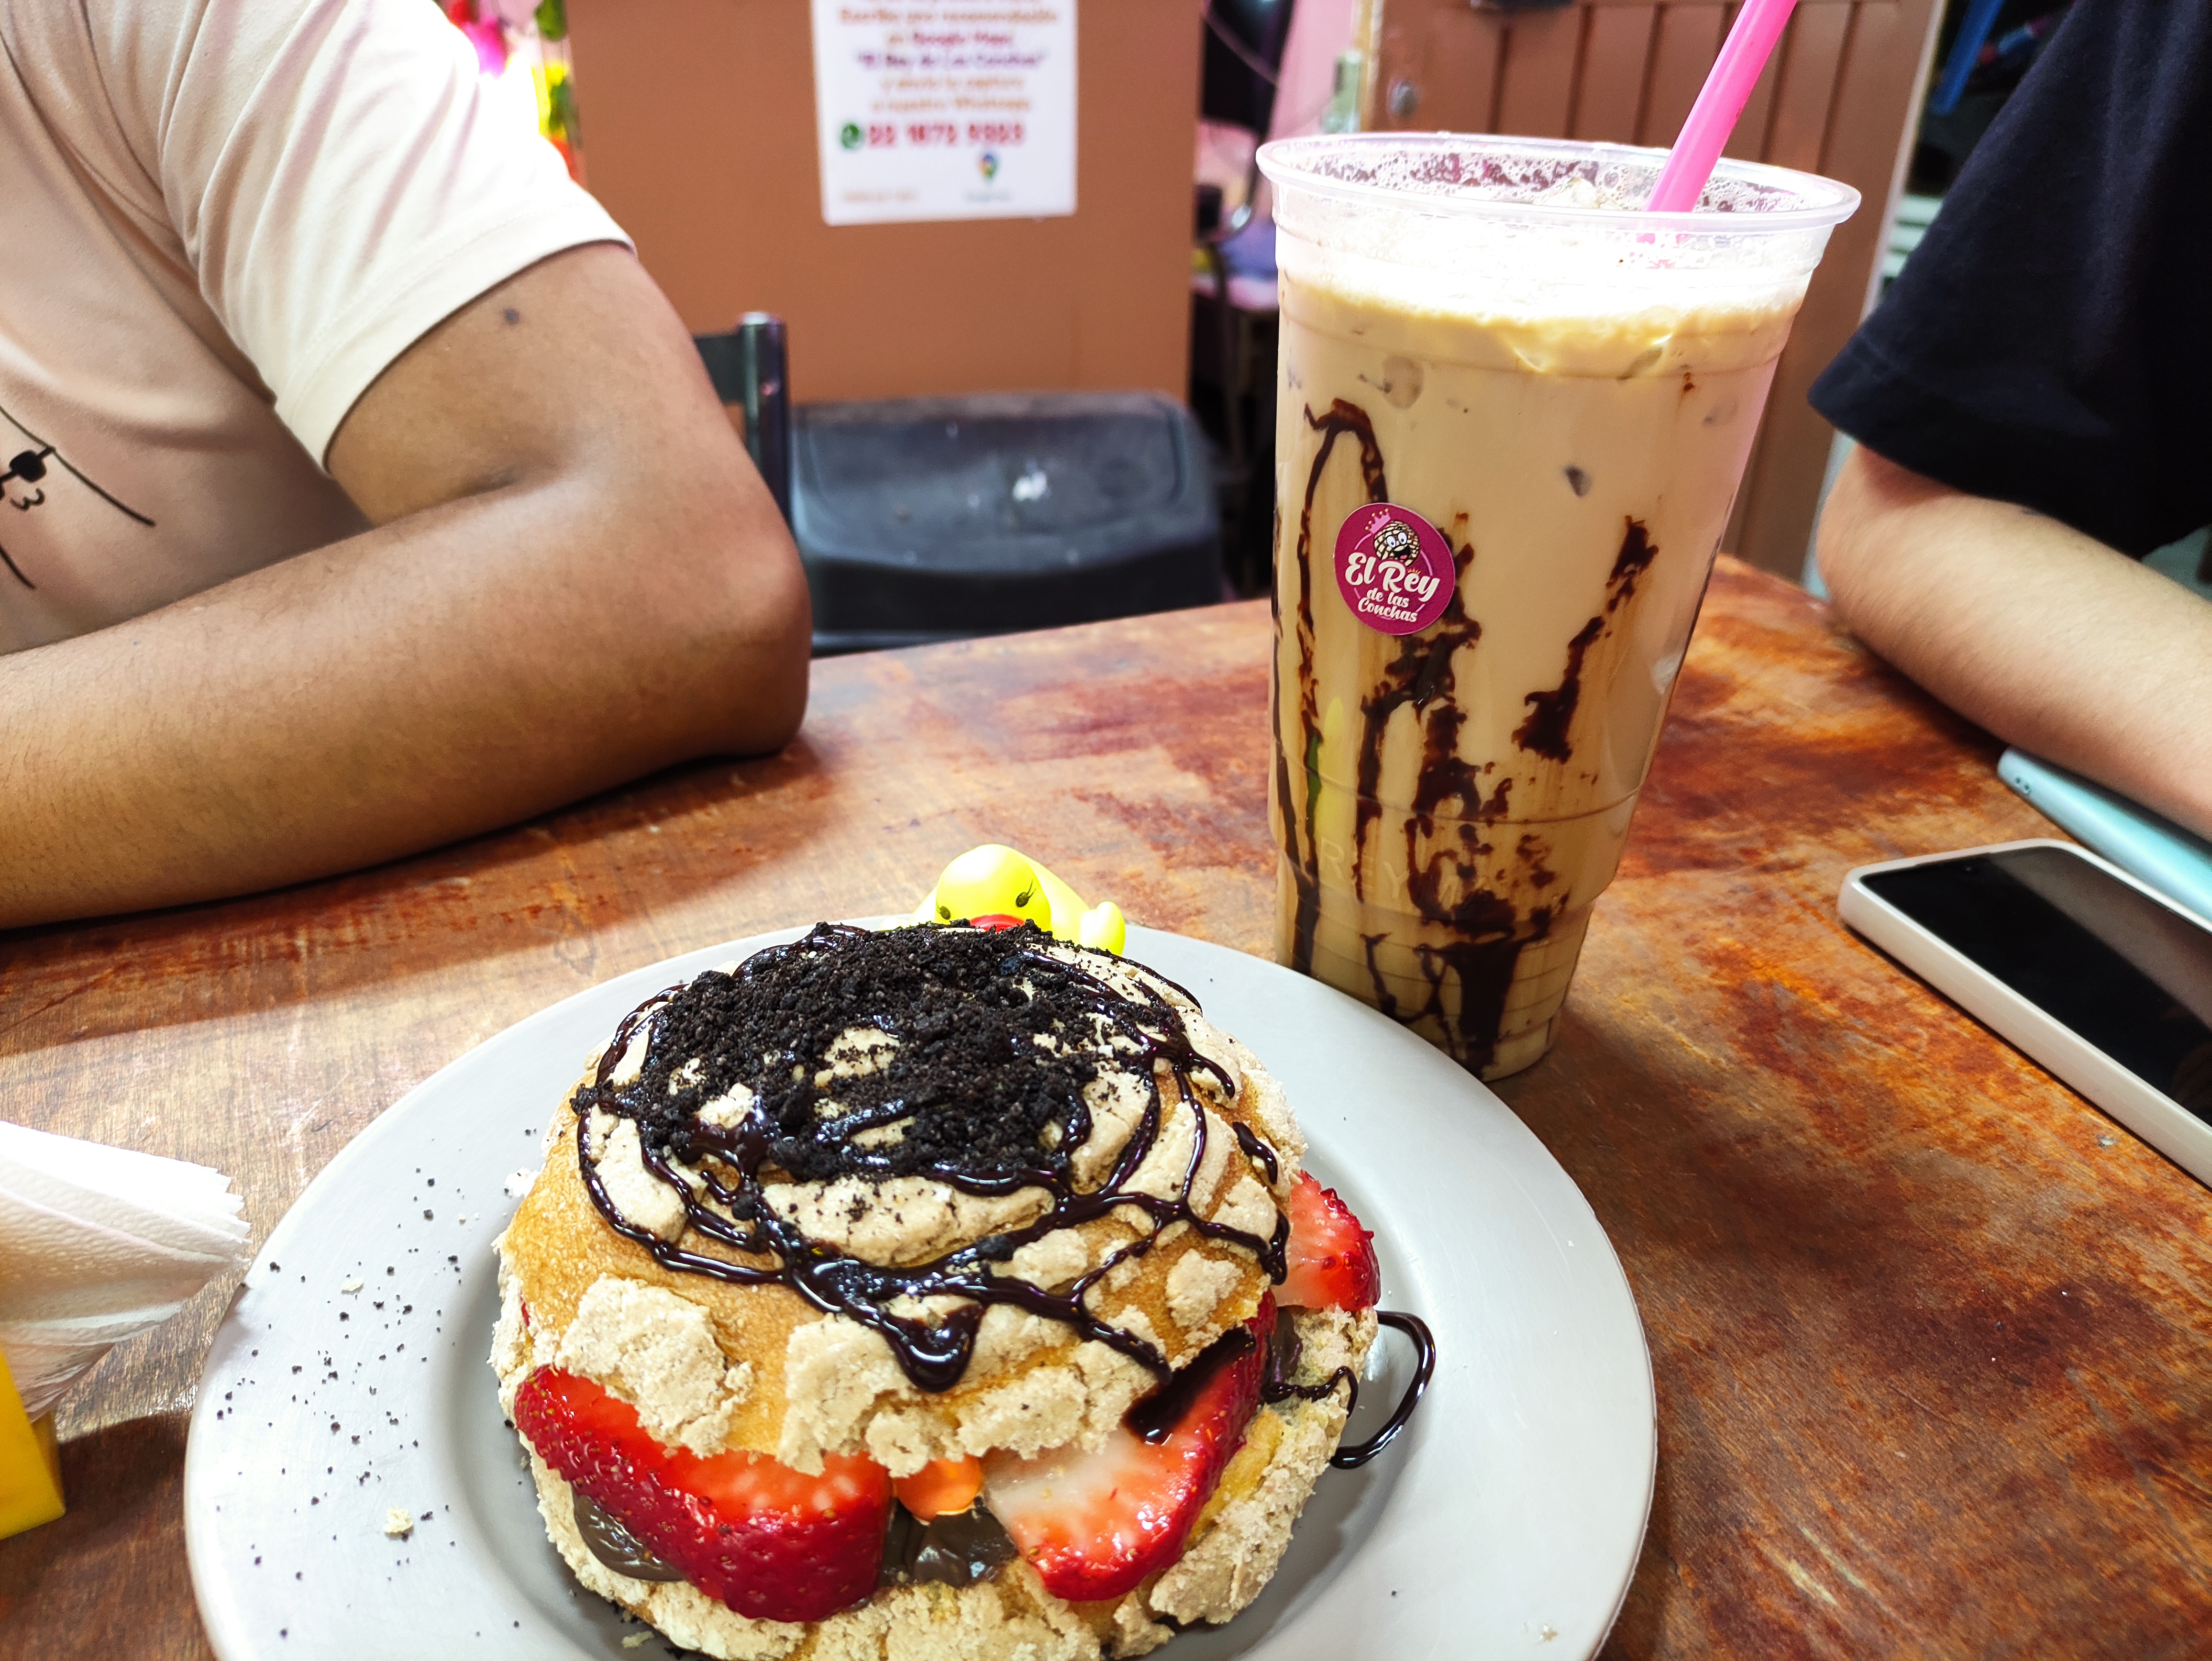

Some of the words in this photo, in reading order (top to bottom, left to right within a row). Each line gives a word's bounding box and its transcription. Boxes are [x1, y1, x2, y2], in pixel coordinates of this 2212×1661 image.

[1345, 552, 1376, 586] El
[1378, 560, 1440, 602] Rey
[1367, 587, 1383, 602] de
[1387, 592, 1409, 608] las
[1358, 598, 1418, 622] Conchas
